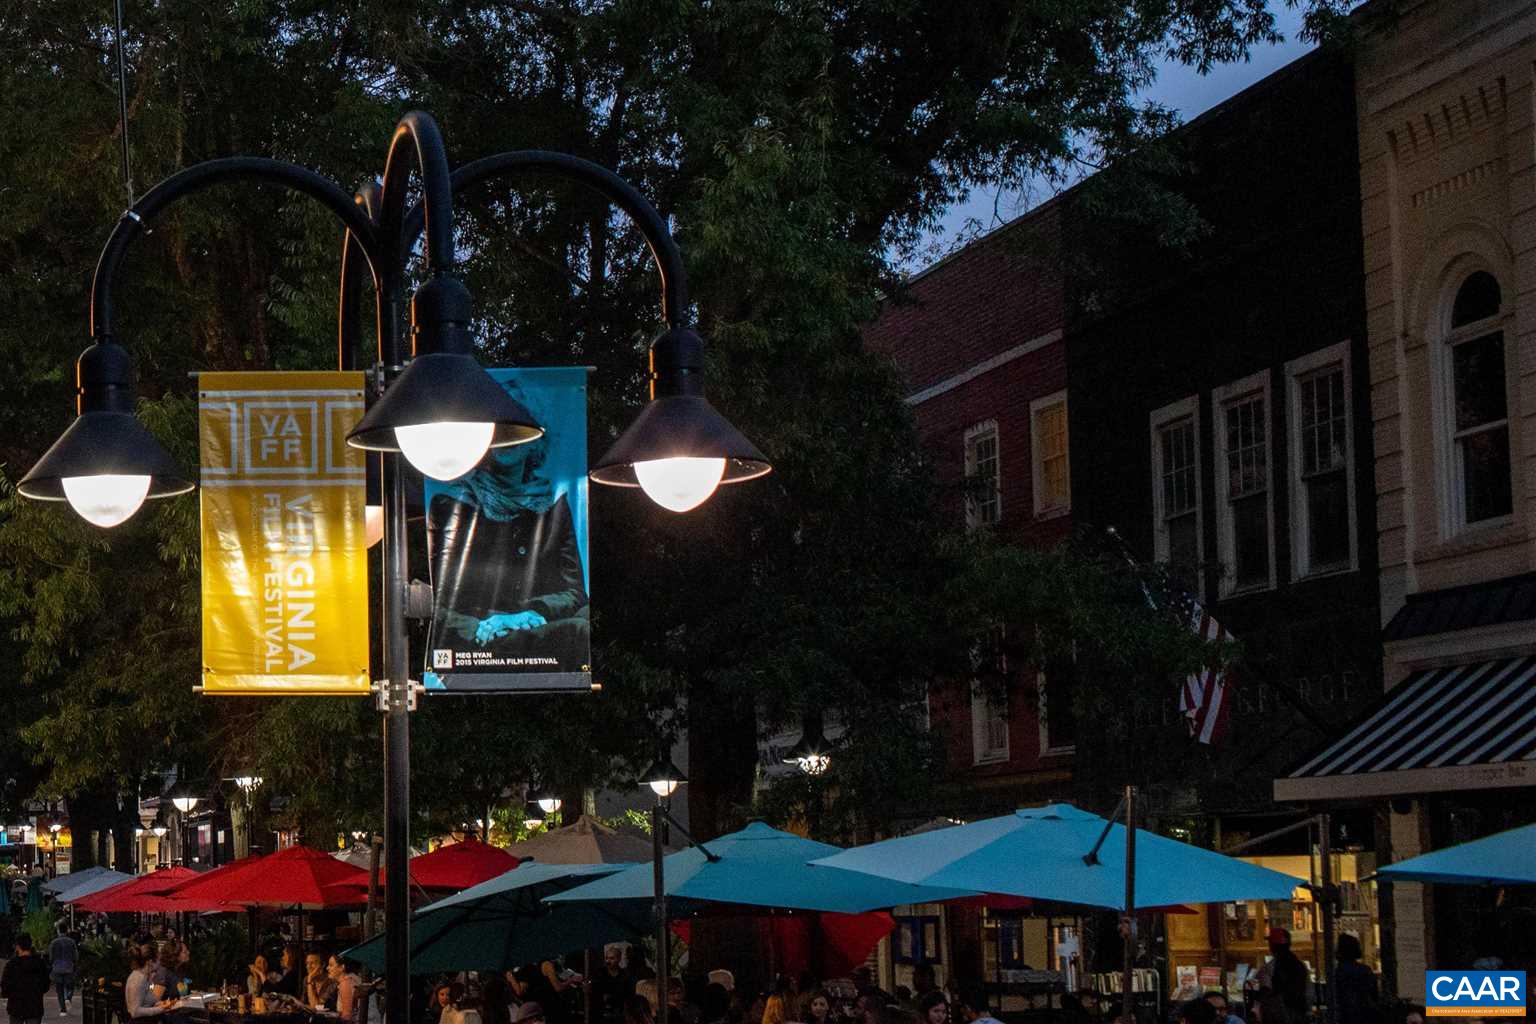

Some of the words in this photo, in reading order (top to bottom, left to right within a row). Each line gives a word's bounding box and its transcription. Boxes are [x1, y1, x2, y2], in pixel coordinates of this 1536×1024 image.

[259, 414, 303, 437] VA
[260, 439, 303, 461] FF
[263, 493, 282, 552] FILM
[286, 493, 316, 672] VIRGINIA
[264, 557, 284, 673] FESTIVAL
